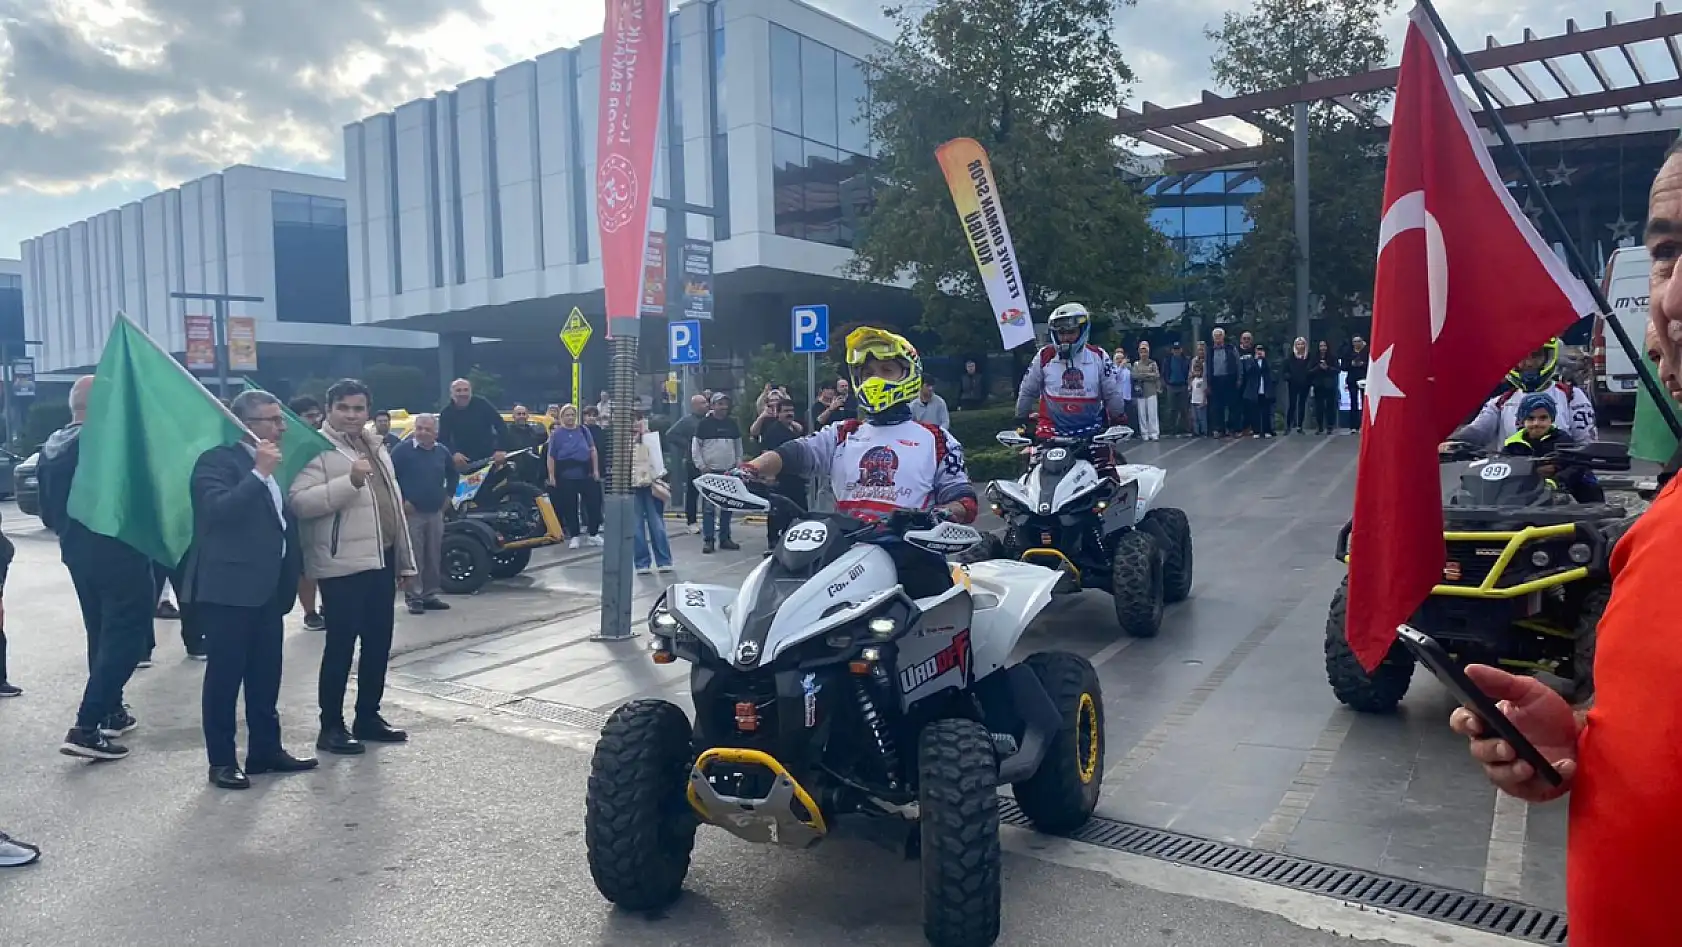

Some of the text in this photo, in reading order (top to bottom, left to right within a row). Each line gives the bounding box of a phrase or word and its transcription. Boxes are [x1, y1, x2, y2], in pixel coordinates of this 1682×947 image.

[795, 310, 818, 348] P
[671, 325, 691, 360] P
[1484, 466, 1508, 477] 991
[786, 528, 827, 544] 883
